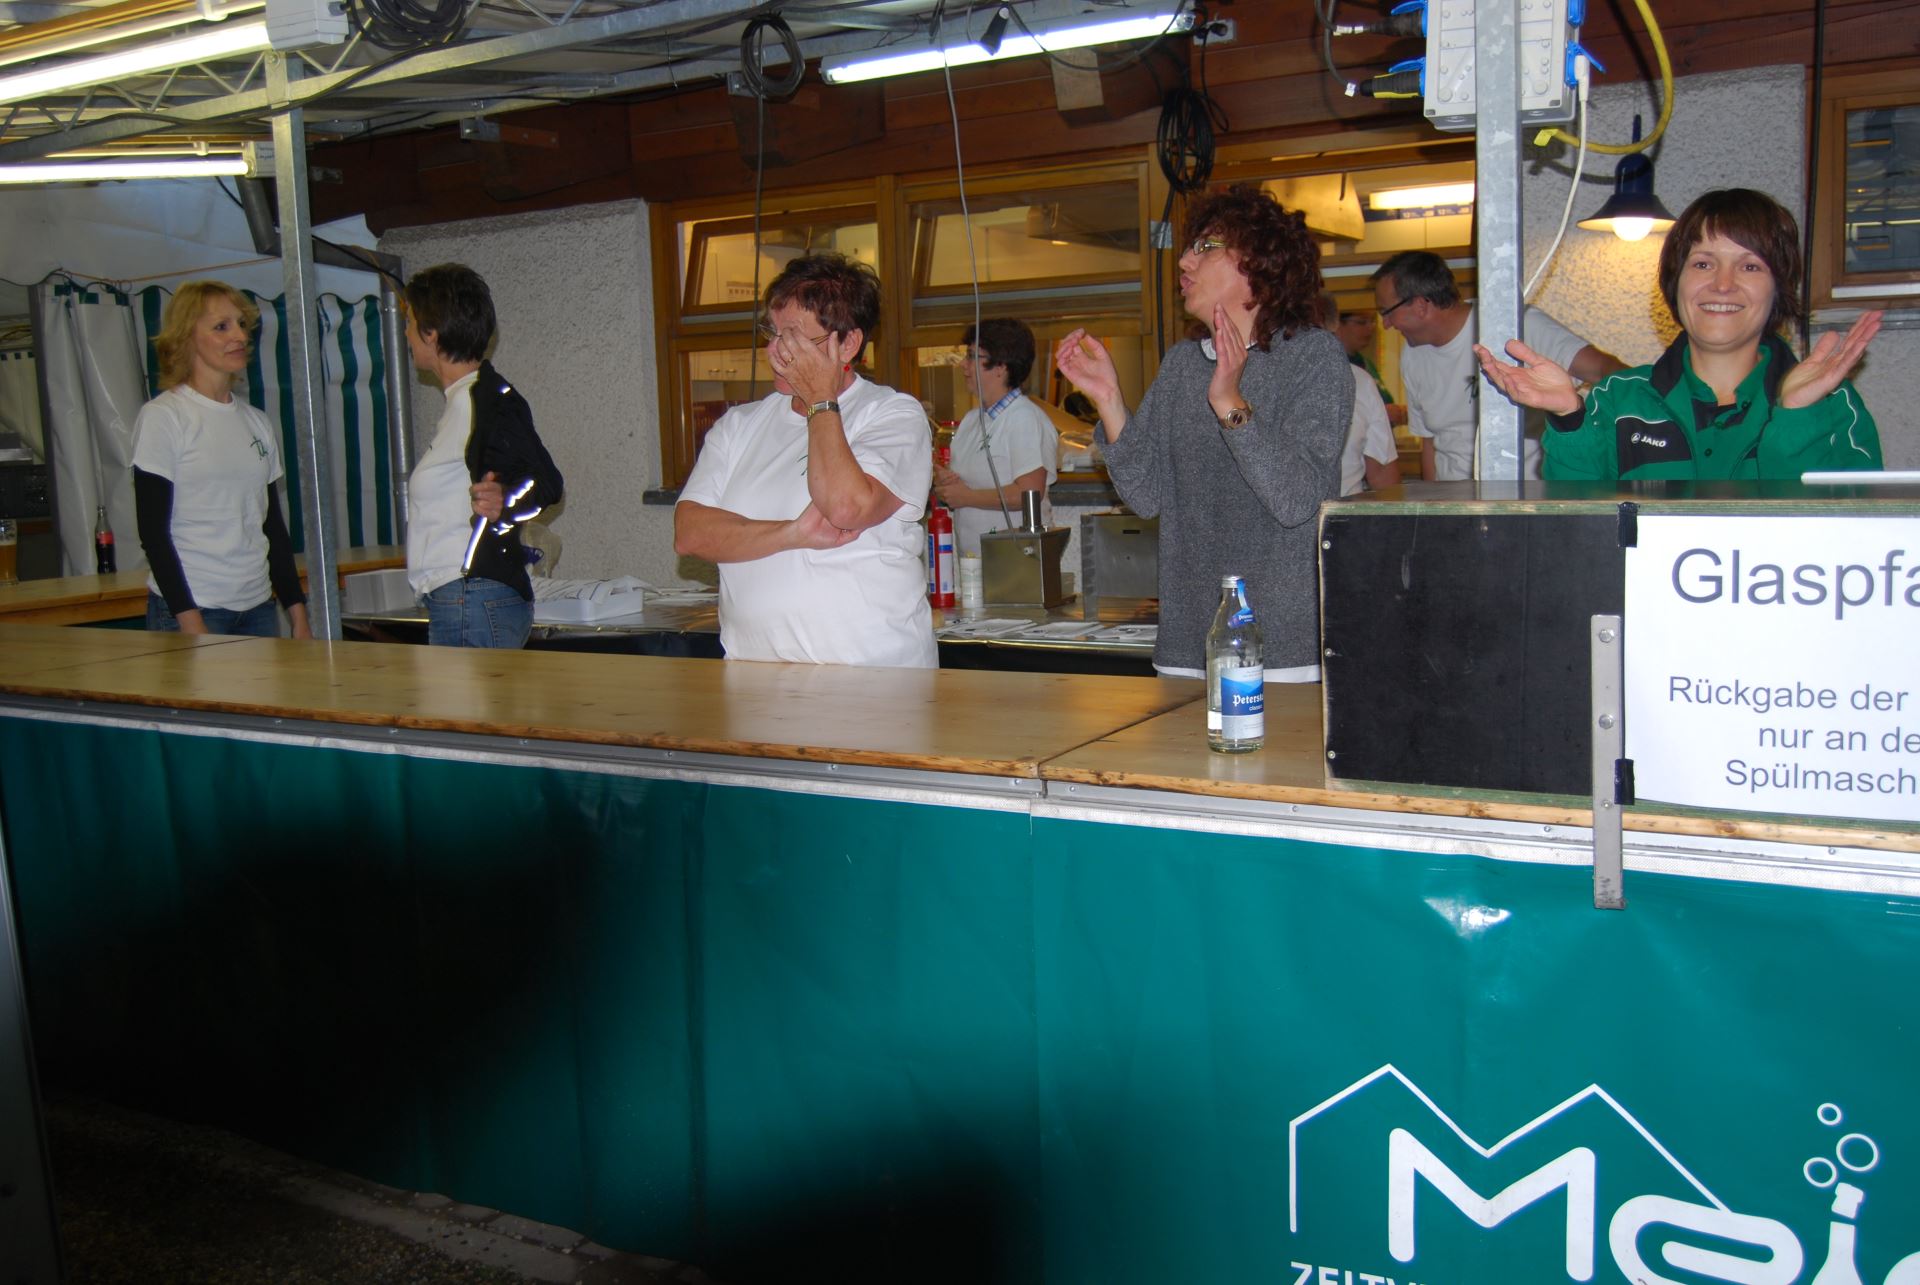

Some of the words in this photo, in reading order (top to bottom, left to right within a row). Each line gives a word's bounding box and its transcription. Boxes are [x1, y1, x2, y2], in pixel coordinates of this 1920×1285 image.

[1640, 435, 1667, 448] JAKO
[1669, 676, 1837, 714] Rückgabe
[1850, 683, 1909, 712] der
[1759, 727, 1813, 749] nur
[1825, 730, 1867, 751] an
[1881, 726, 1920, 754] de
[1726, 759, 1917, 795] Spülmasch
